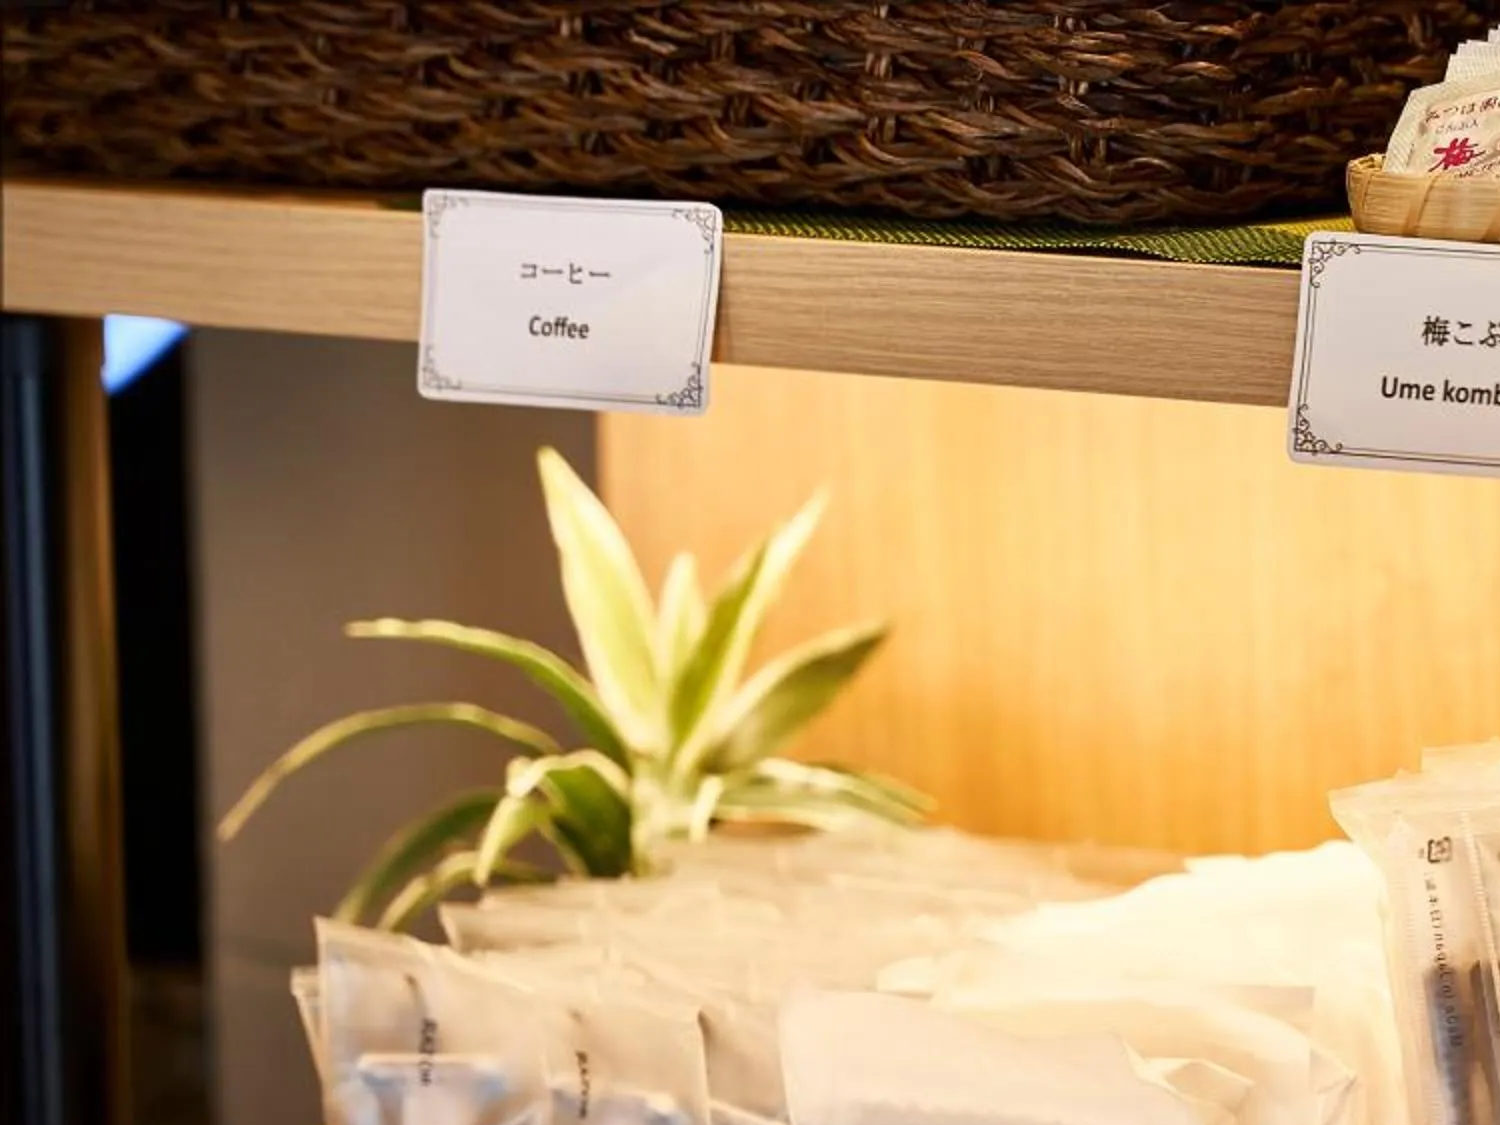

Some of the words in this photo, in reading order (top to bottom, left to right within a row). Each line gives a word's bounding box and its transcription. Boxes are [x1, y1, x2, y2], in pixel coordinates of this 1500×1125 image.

[520, 263, 611, 285] コーヒー
[528, 315, 590, 340] Coffee
[1381, 375, 1435, 401] Ume
